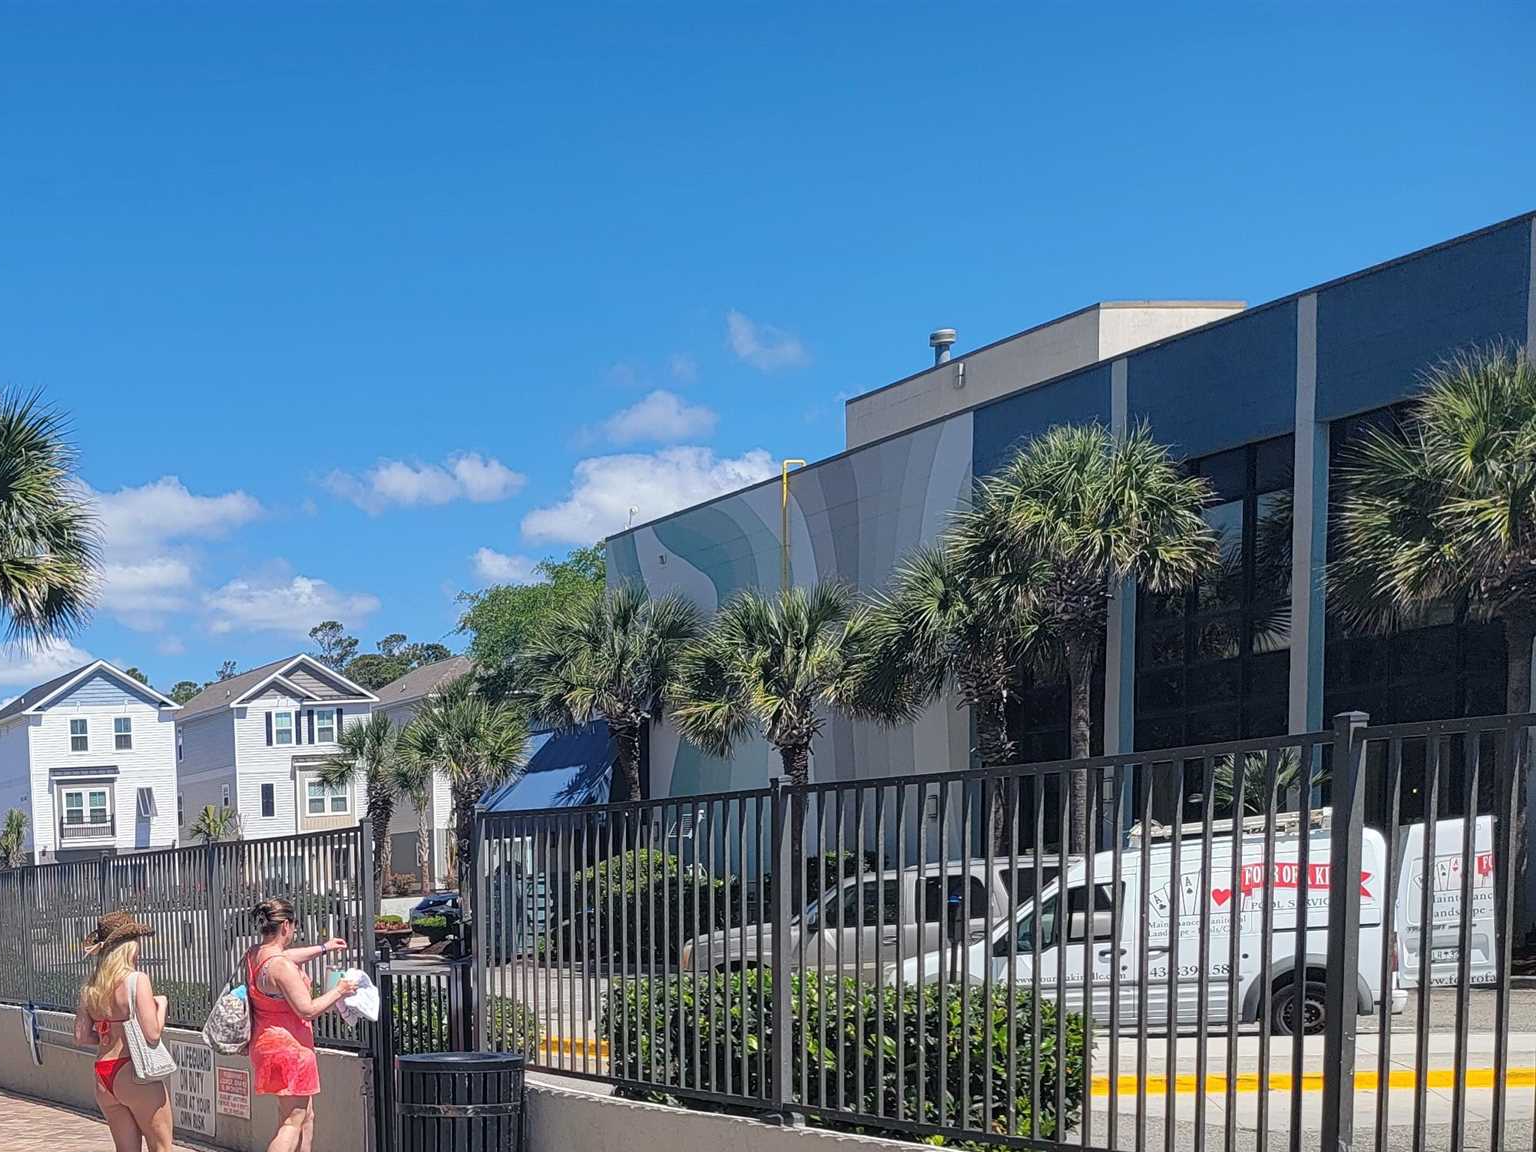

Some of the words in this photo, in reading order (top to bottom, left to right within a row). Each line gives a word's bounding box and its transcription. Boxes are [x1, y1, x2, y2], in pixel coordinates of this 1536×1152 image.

[1245, 865, 1279, 886] FOR
[181, 1045, 211, 1072] LIFEGUARD
[189, 1070, 204, 1095] DUTY
